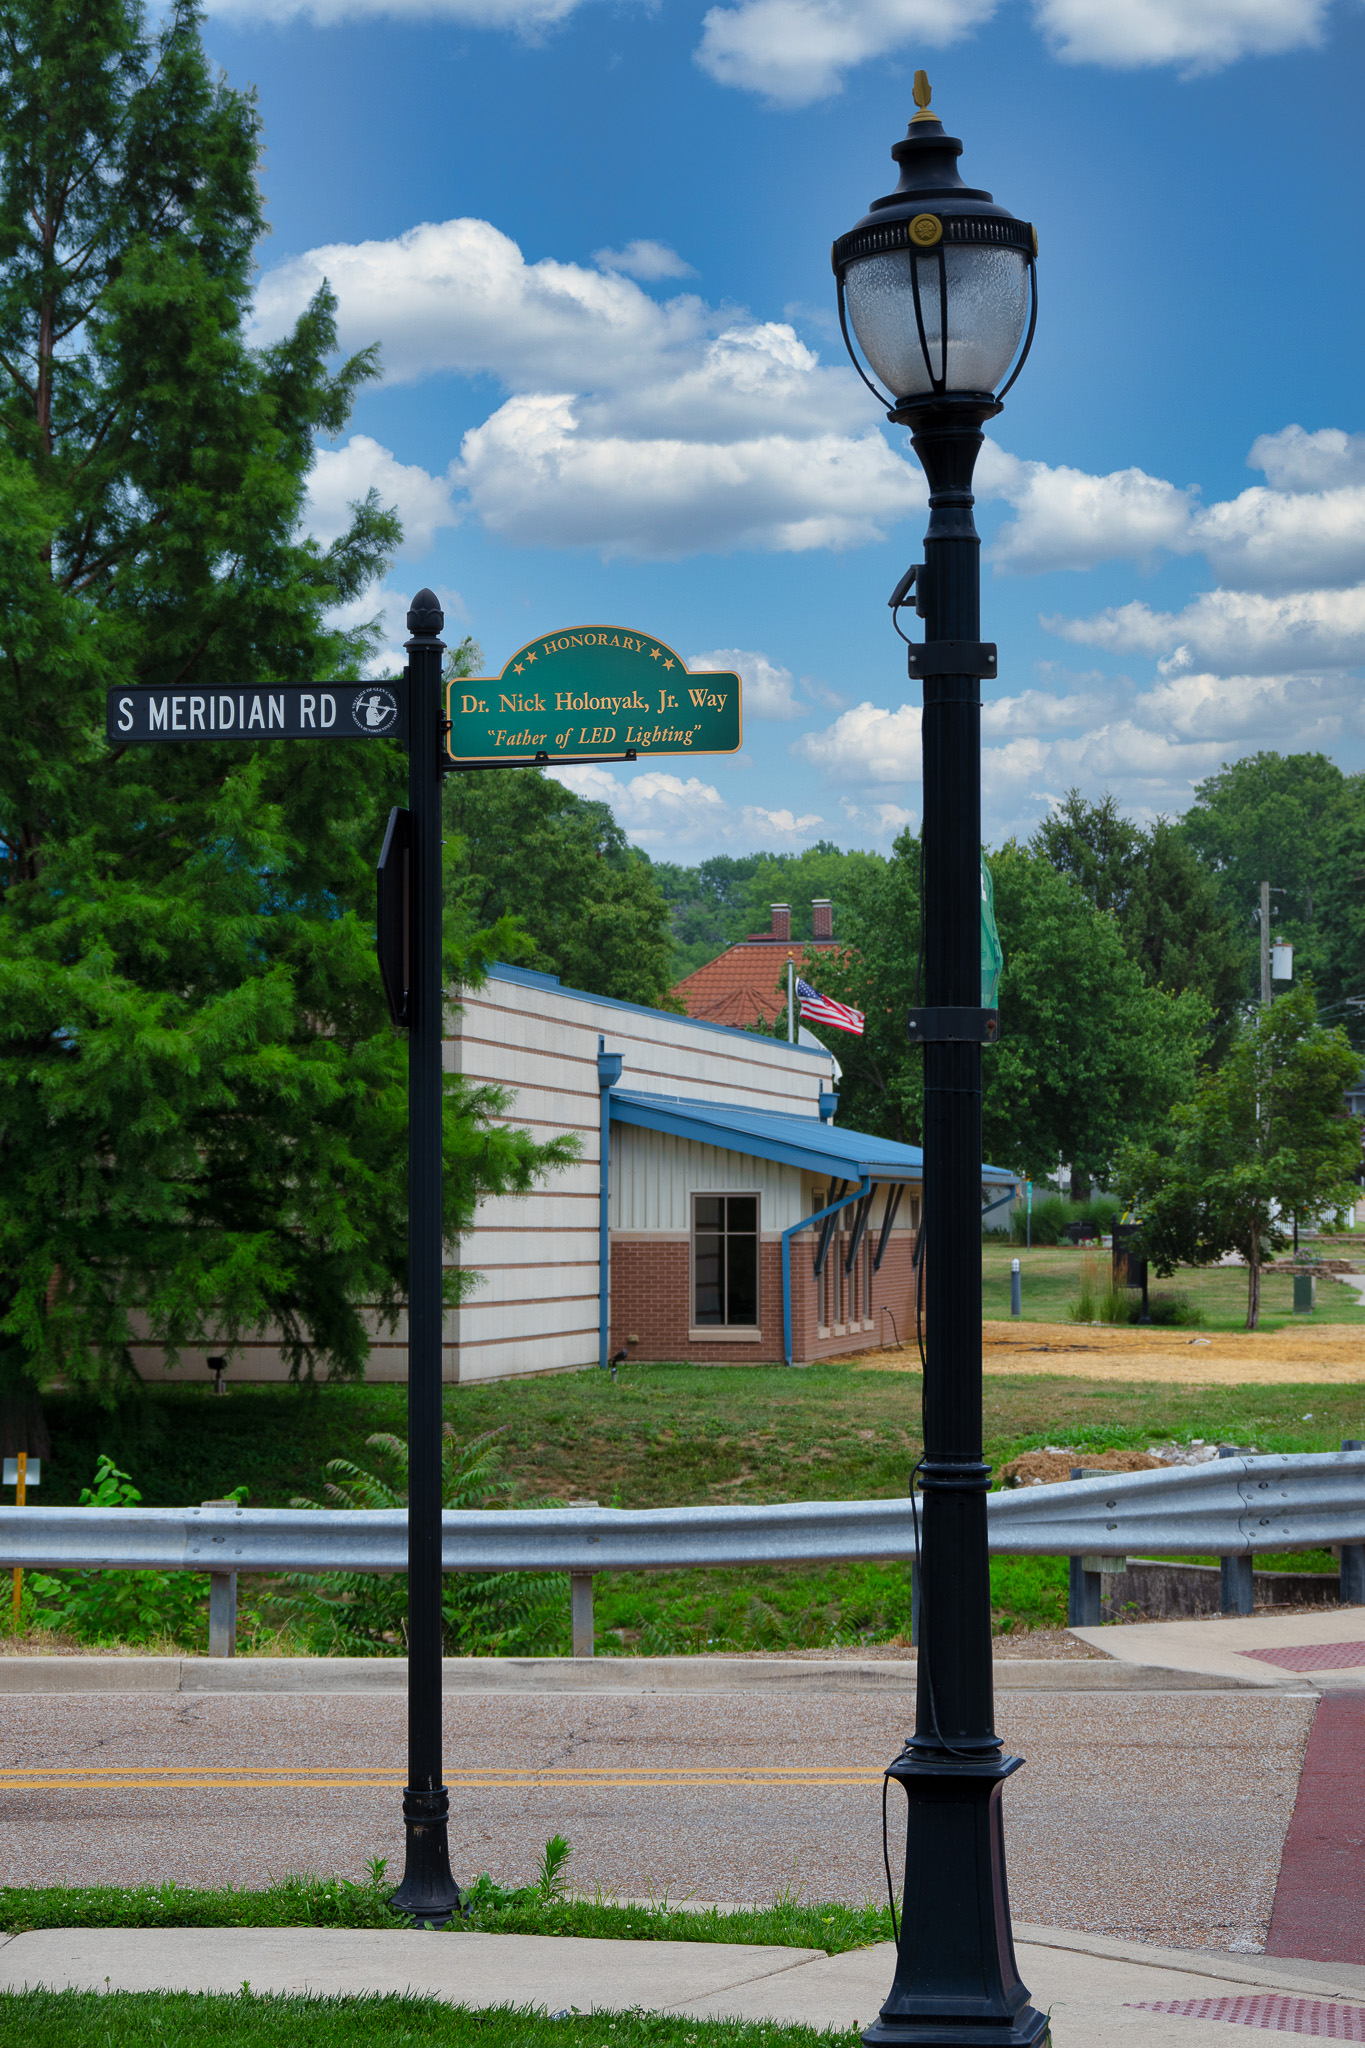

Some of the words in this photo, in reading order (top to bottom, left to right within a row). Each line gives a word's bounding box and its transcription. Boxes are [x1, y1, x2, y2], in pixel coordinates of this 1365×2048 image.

[542, 633, 647, 656] HONORARY
[117, 697, 134, 732] S
[149, 694, 285, 731] MERIDIAN
[300, 694, 337, 729] RD
[460, 694, 490, 713] Dr.
[498, 693, 547, 713] Nick
[554, 690, 650, 716] Holonyak,
[656, 689, 679, 714] Jr.
[688, 688, 728, 713] Way
[487, 729, 547, 746] “Father
[555, 728, 574, 749] of
[578, 727, 617, 744] LED
[624, 724, 702, 747] Lighting”
